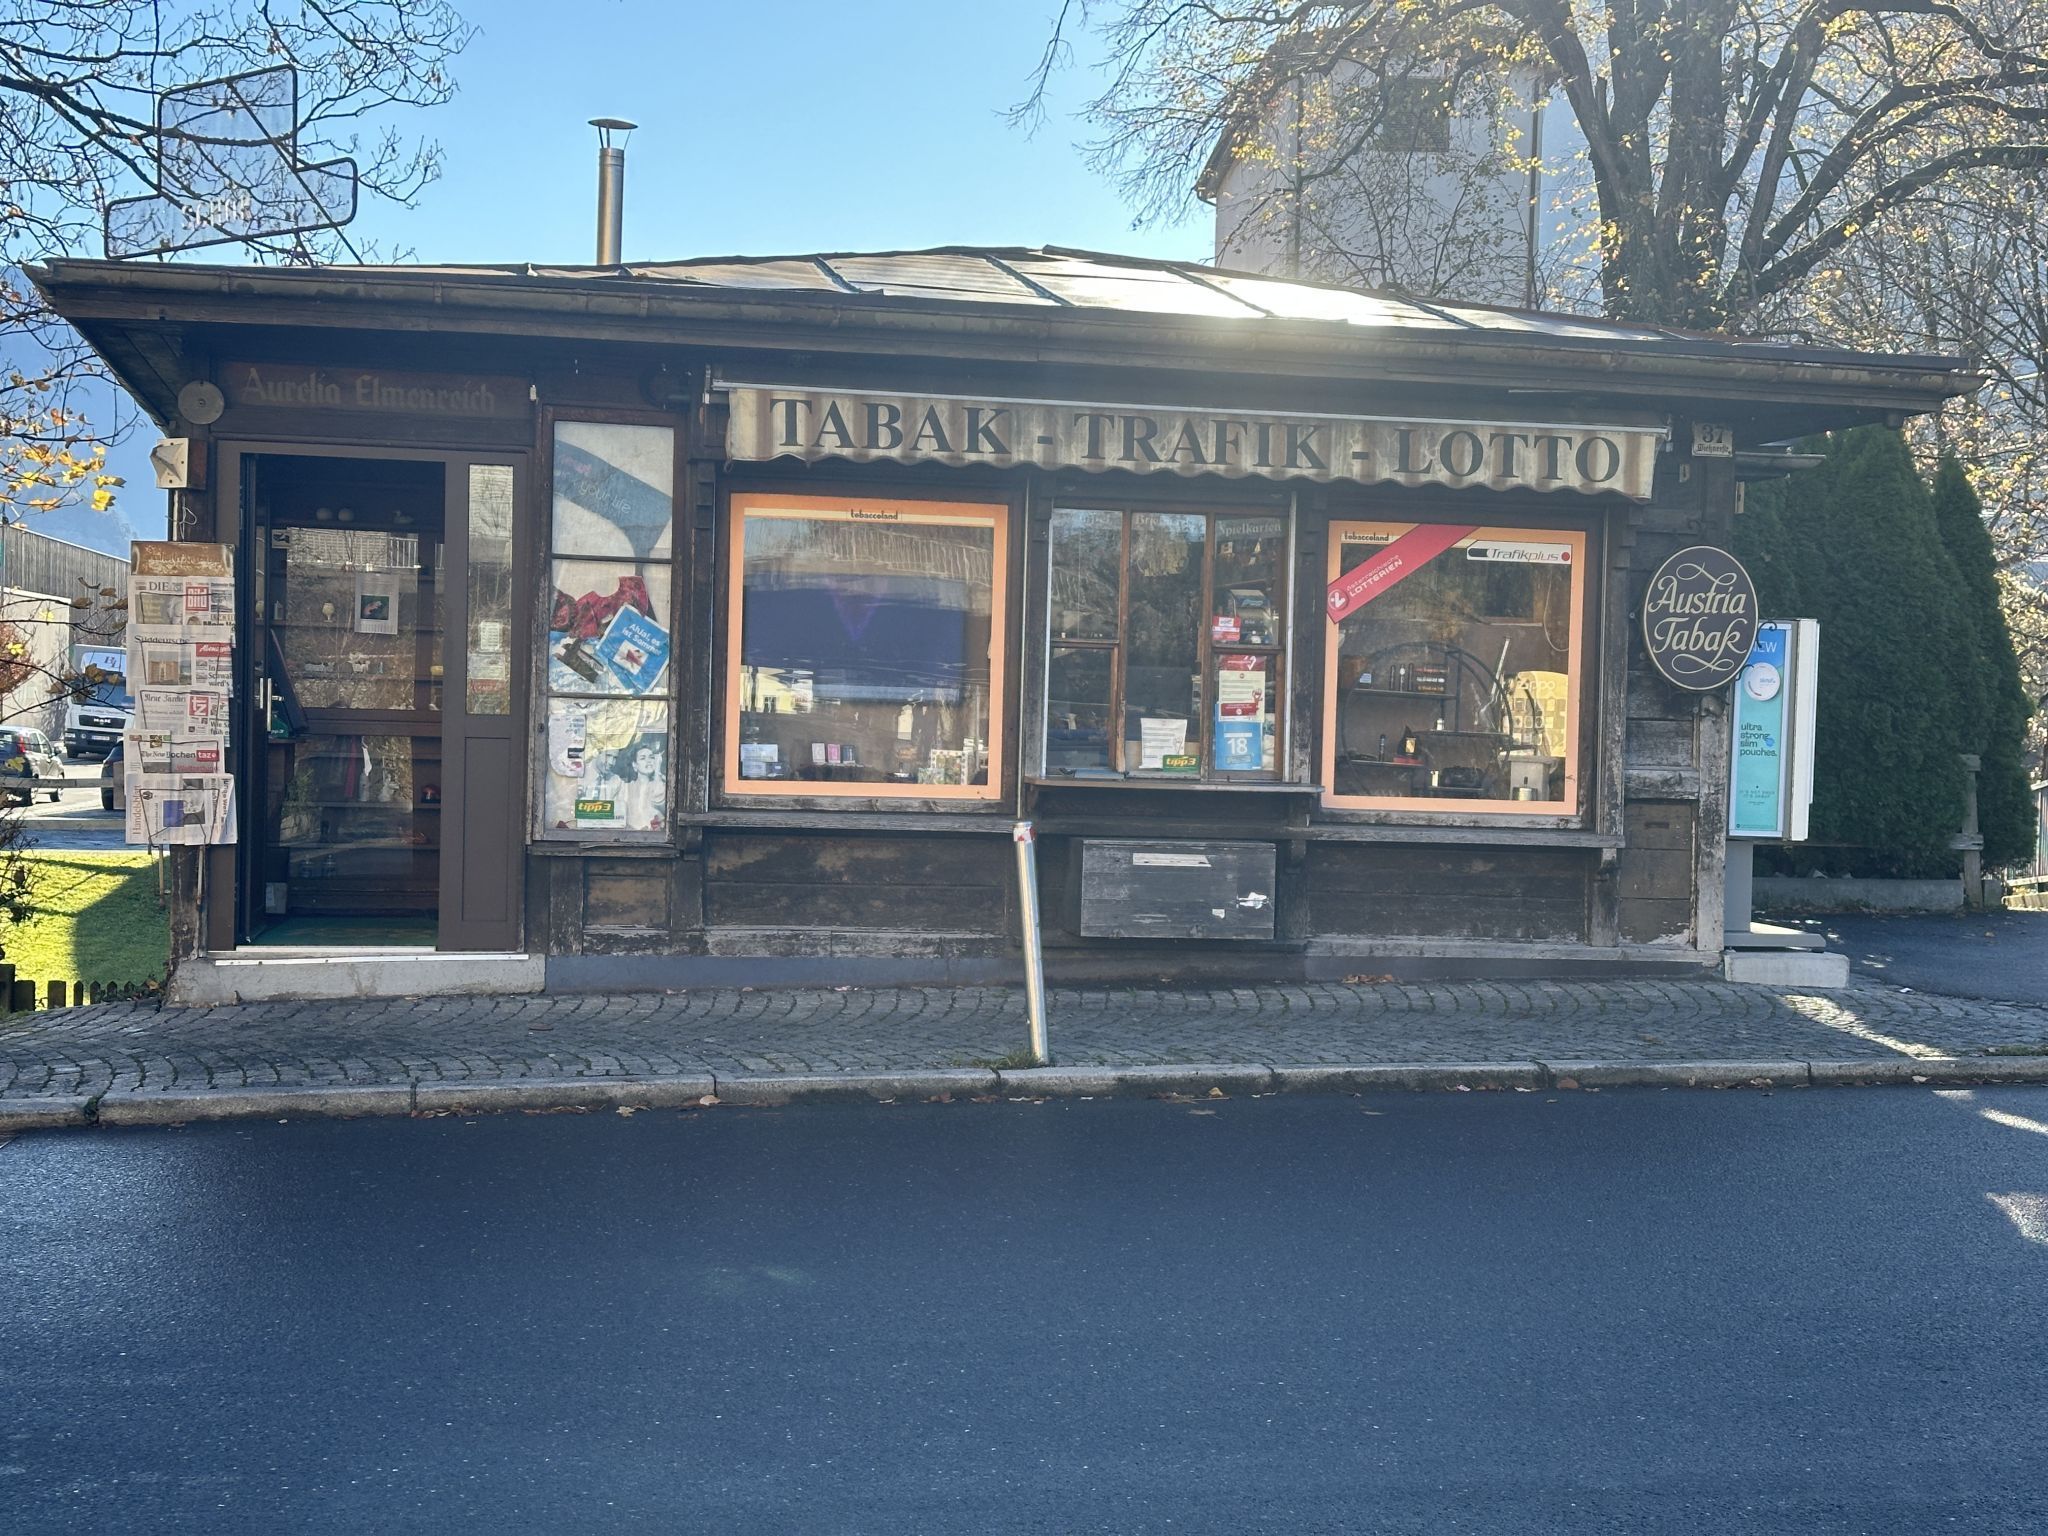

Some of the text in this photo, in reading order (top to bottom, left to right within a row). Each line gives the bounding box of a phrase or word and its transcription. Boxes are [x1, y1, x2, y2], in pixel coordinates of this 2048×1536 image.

[238, 367, 496, 415] Aurelia Elmenreich
[770, 398, 1012, 454] TABAK
[1073, 413, 1329, 469] TRAFIK
[1393, 428, 1621, 483] LOTTO
[1702, 424, 1723, 443] 37
[611, 496, 632, 514] life
[850, 509, 899, 520] tobaccoland
[1219, 520, 1282, 538] Spielkarten
[1344, 531, 1390, 542] tobaccoland
[1491, 548, 1560, 562] Trafikplus
[148, 581, 169, 592] DIE
[1349, 559, 1403, 598] LOTTERIEN
[1648, 563, 1748, 614] Austria
[1653, 617, 1749, 673] Tabak
[190, 696, 208, 716] tz
[1741, 723, 1763, 731] ultra
[1740, 732, 1771, 742] strong
[1227, 737, 1249, 756] 18
[1740, 747, 1777, 757] pouches.
[1165, 756, 1197, 768] tipp3
[577, 801, 612, 812] tipp3
